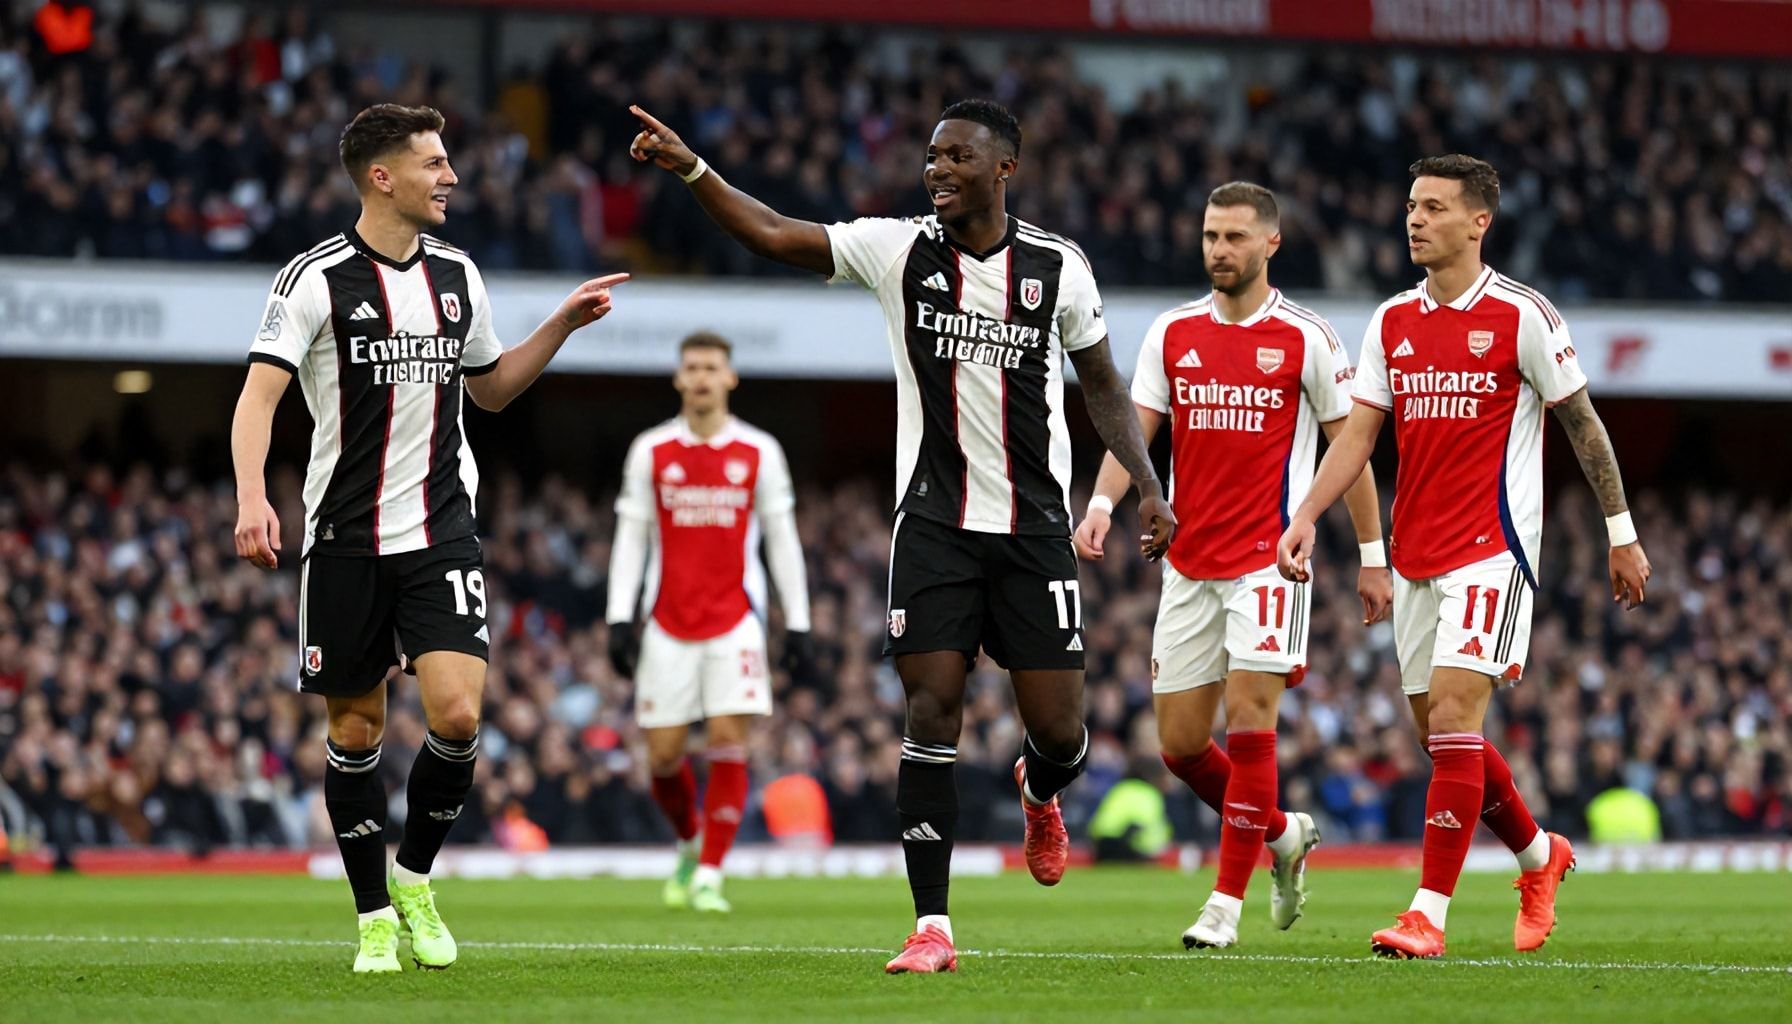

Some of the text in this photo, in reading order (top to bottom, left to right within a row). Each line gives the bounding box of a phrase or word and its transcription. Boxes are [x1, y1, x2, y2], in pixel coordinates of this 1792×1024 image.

[1174, 377, 1284, 409] Emirates
[445, 569, 487, 619] 19
[1252, 586, 1286, 629] 11
[1462, 585, 1499, 634] 11
